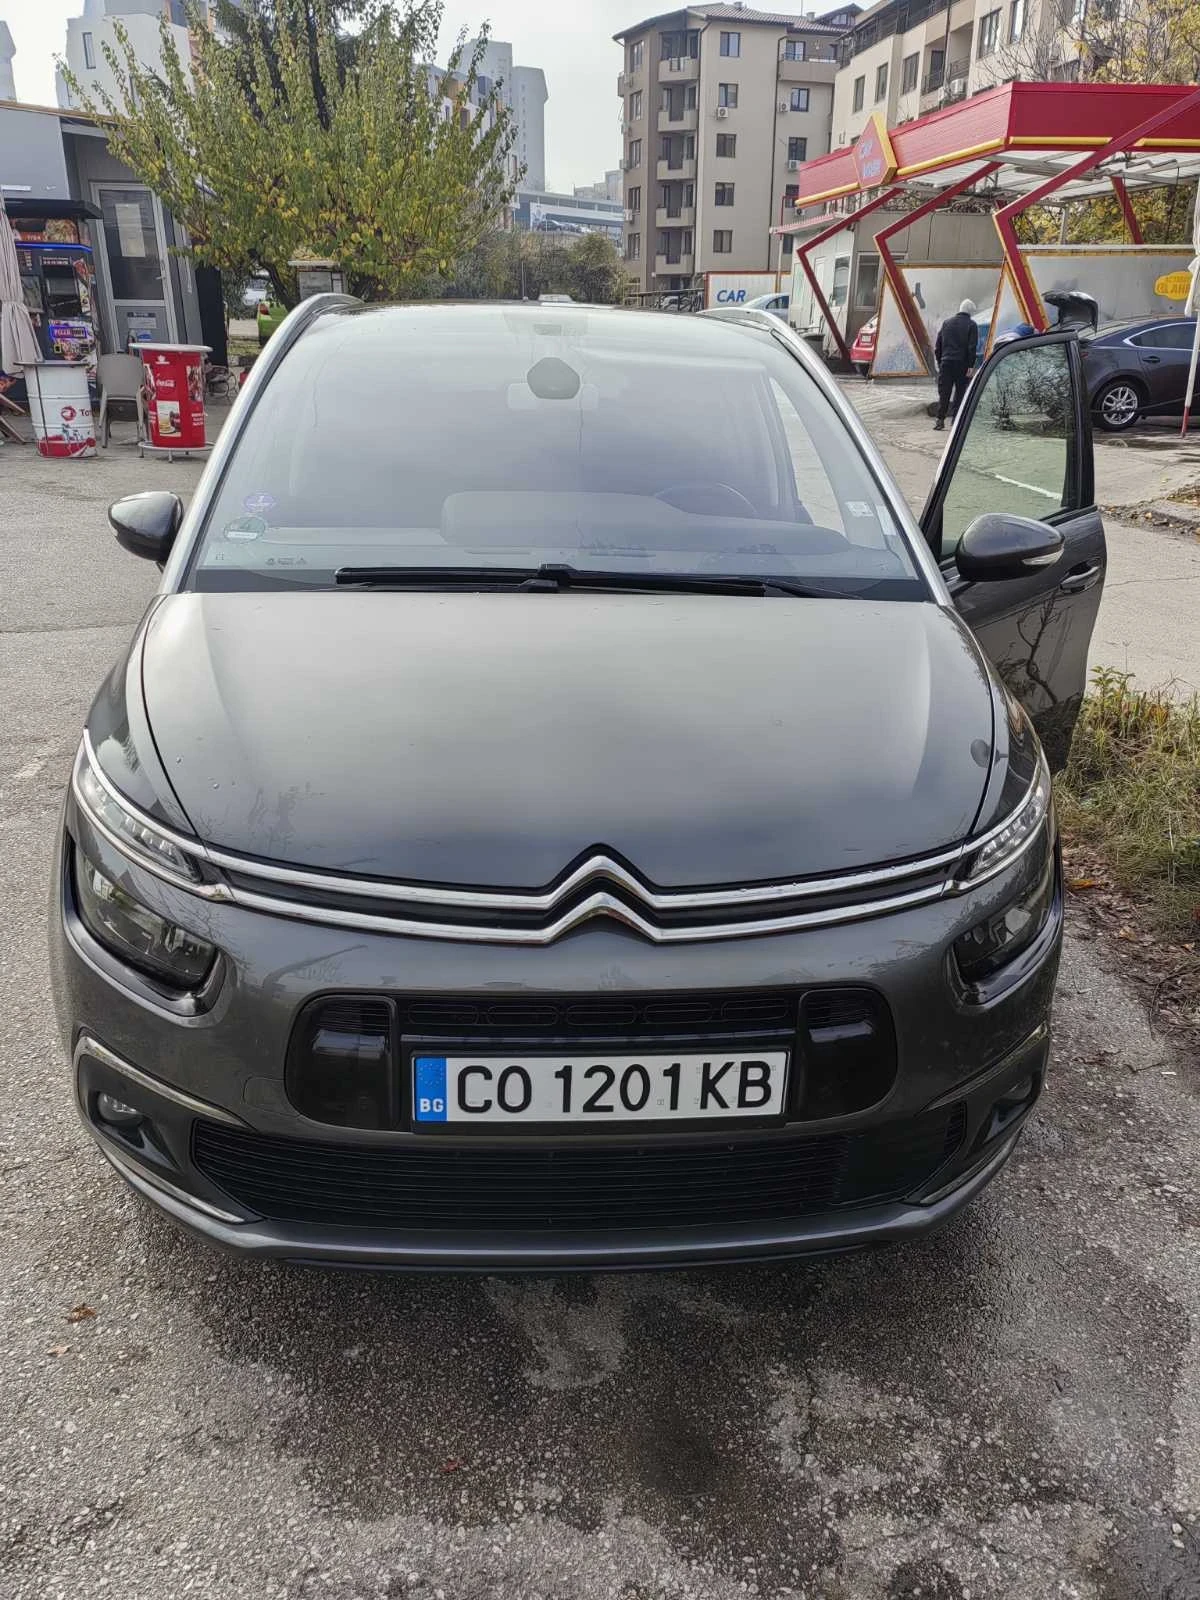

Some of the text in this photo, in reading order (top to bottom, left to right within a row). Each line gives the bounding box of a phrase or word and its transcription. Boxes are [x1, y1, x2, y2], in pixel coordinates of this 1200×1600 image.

[717, 289, 747, 302] CAR
[457, 1060, 773, 1113] CO 1201 KB
[420, 1097, 444, 1112] BG
